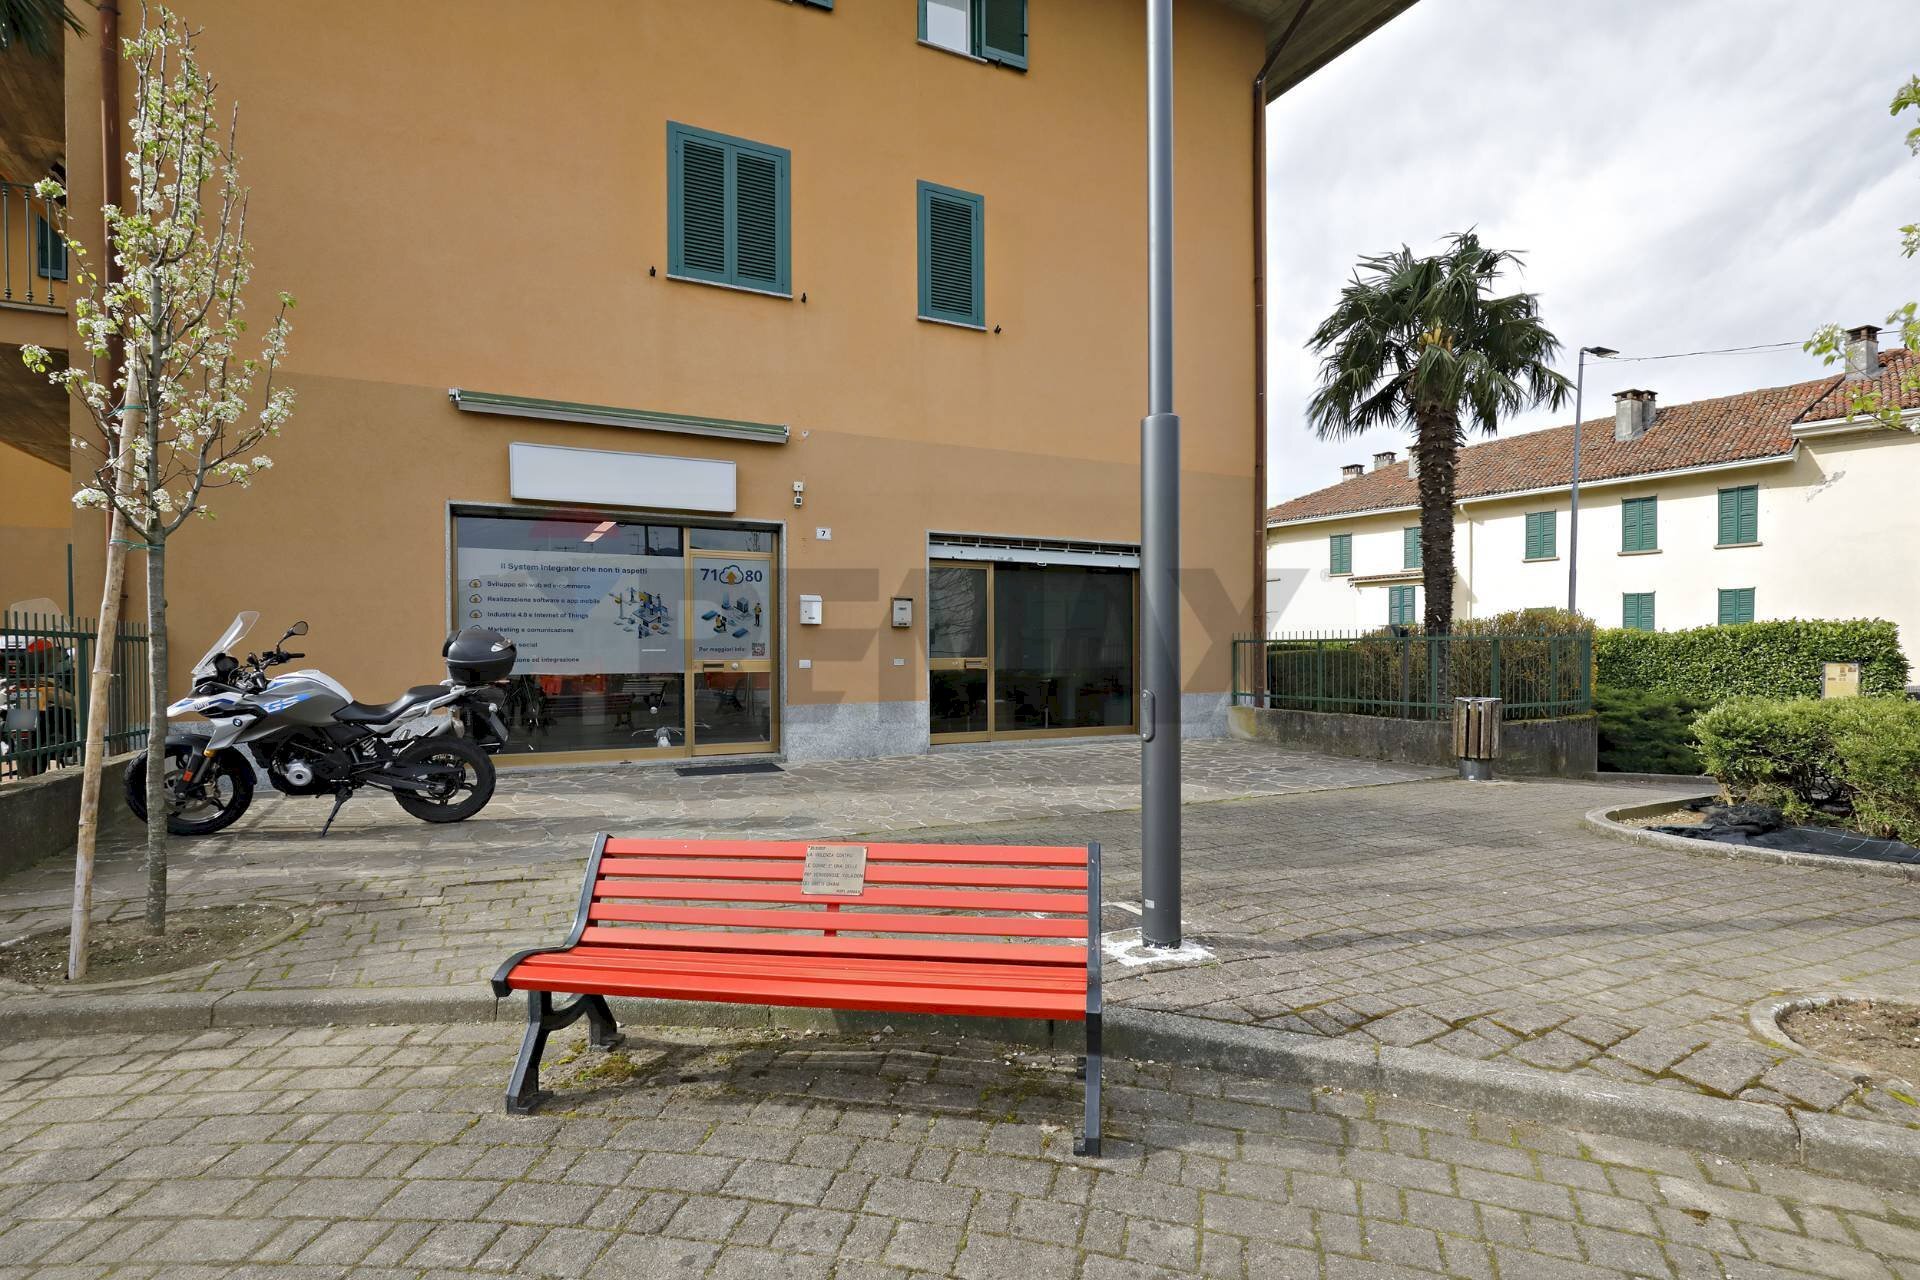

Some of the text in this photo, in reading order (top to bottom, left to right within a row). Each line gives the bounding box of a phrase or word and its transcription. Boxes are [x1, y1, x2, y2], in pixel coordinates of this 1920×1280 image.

[508, 562, 539, 571] System
[540, 563, 580, 572] Integrator
[622, 567, 648, 575] aspetti
[700, 568, 717, 581] 71
[746, 570, 763, 582] 80
[487, 580, 516, 588] Sviluppo
[487, 595, 531, 603] Realizzazione
[567, 612, 589, 620] Things
[487, 626, 520, 634] Marketing
[709, 646, 734, 654] maggiori
[541, 656, 580, 665] integrazione
